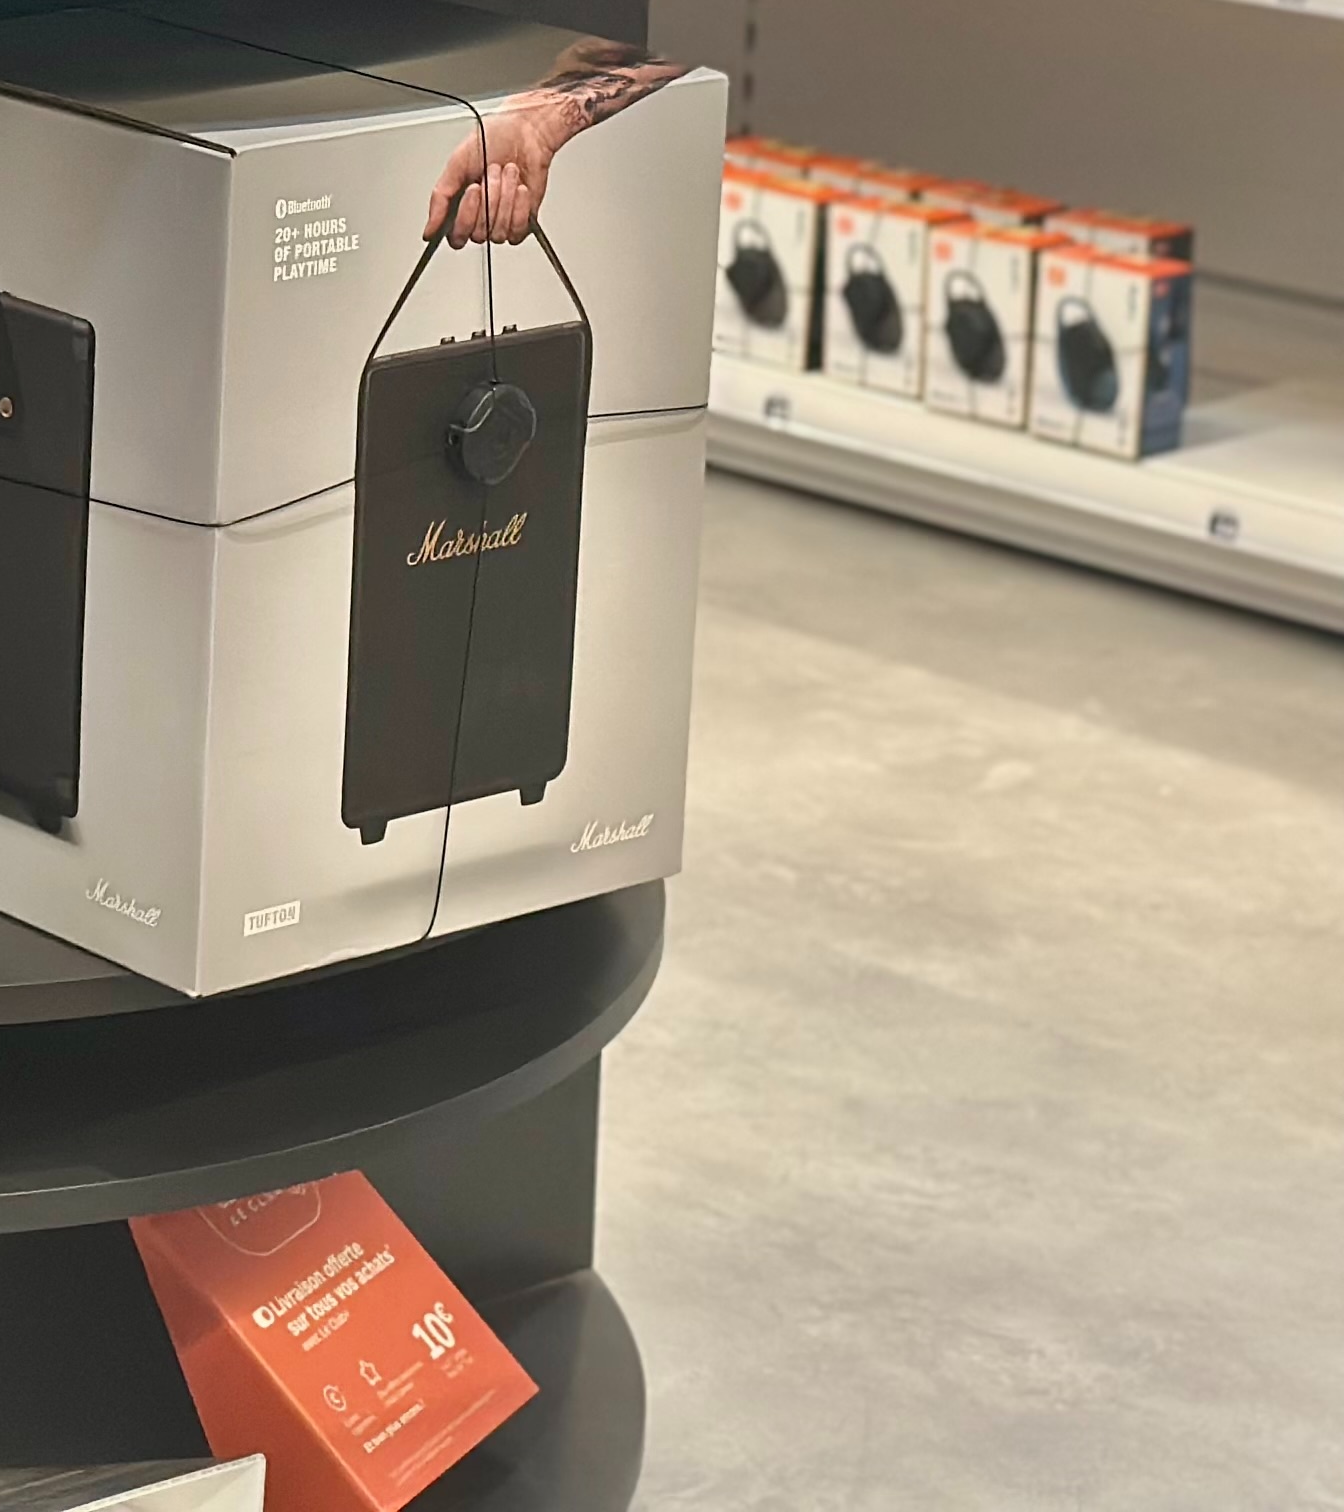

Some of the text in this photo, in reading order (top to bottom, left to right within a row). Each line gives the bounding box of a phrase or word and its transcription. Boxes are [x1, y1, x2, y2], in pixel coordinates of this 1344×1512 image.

[274, 217, 347, 244] 20+ HOURS
[274, 234, 359, 263] OF PORTABLE
[274, 257, 337, 282] PLAYTIME
[406, 511, 529, 566] Marshall
[570, 813, 654, 854] Marshall
[85, 877, 162, 928] Marshall
[248, 905, 296, 931] TUFTON
[268, 1241, 365, 1317] Livraison offerte
[287, 1311, 312, 1337] sur
[305, 1293, 339, 1321] tous
[333, 1276, 359, 1300] vos
